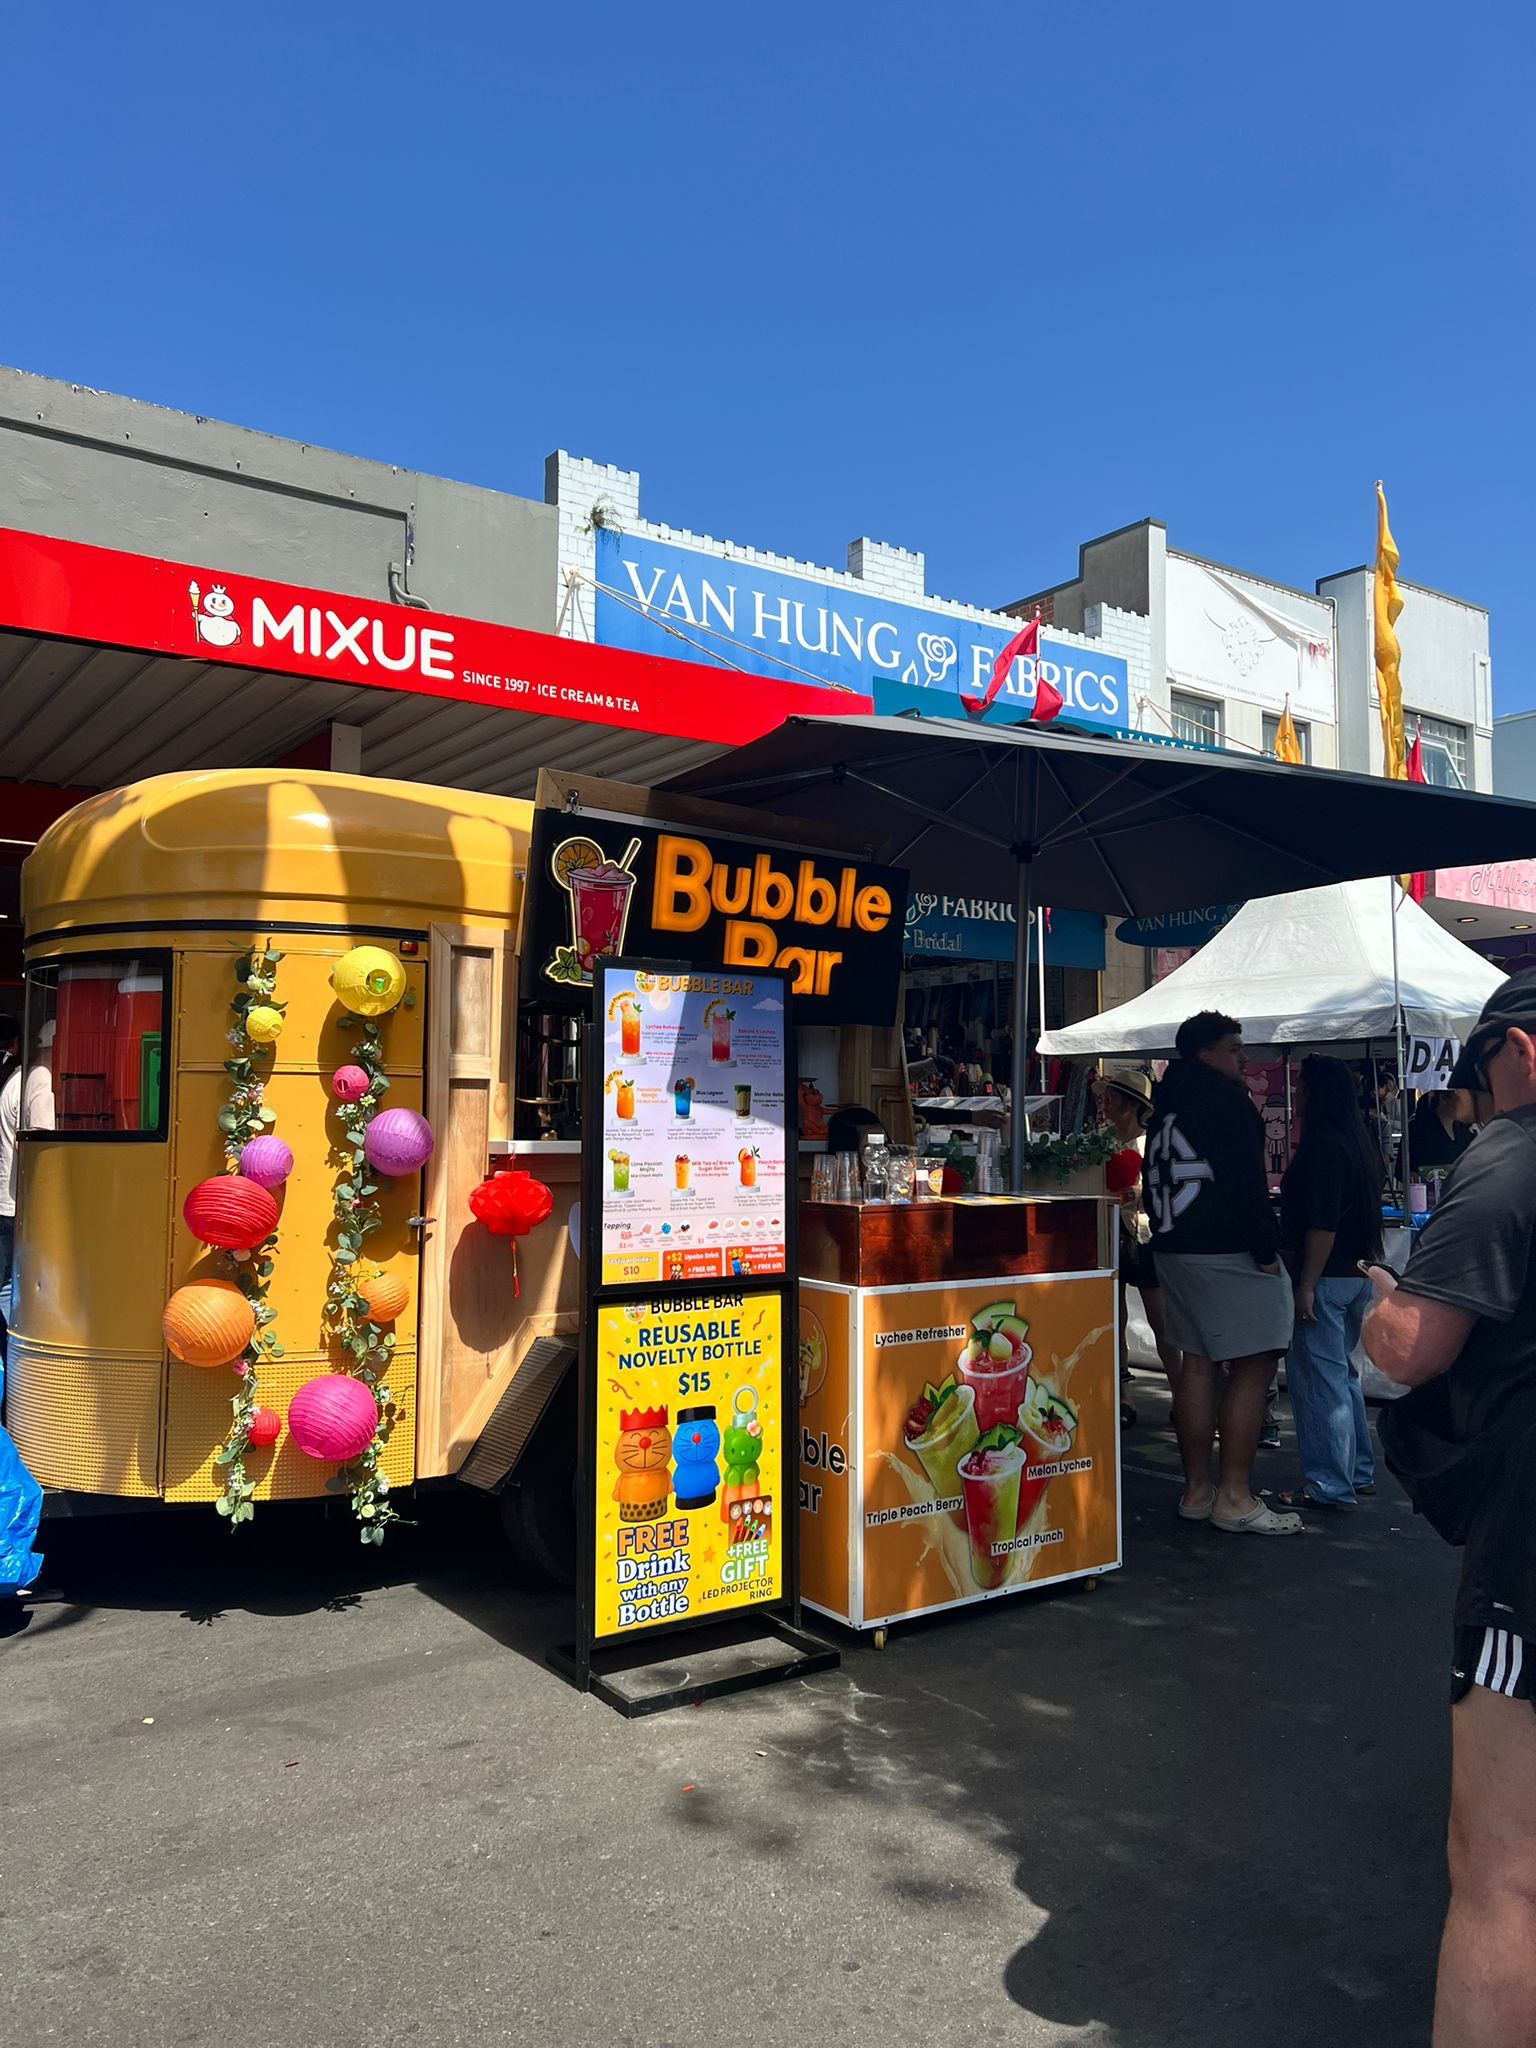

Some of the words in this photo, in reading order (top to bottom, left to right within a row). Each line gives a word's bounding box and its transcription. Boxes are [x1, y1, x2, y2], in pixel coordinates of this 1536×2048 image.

[622, 558, 737, 633] VAN
[751, 590, 903, 670] HUNG
[252, 597, 456, 681] MIXUE
[462, 670, 501, 689] SINCE
[504, 677, 530, 694] 1997
[537, 683, 558, 698] ICE
[560, 687, 603, 706] CREAM
[615, 697, 640, 712] TEA
[651, 834, 892, 933] Bubble
[1136, 914, 1165, 932] VAN
[1169, 906, 1217, 928] HUNG
[913, 929, 962, 951] Bridal
[657, 975, 721, 994] BUBBLE
[721, 977, 754, 996] BAR
[623, 1265, 640, 1276] $10
[650, 1296, 710, 1315] BUBBLE
[713, 1293, 744, 1310] BAR
[638, 1319, 741, 1348] REUSABLE
[874, 1330, 914, 1346] Lychee
[915, 1325, 966, 1341] Refresher
[618, 1346, 698, 1370] NOVELTY
[702, 1339, 762, 1361] BOTTLE
[678, 1371, 711, 1396] $15
[1028, 1464, 1057, 1479] Melon
[1058, 1458, 1092, 1475] Lychee
[866, 1511, 898, 1527] Triple
[899, 1503, 934, 1520] Peach
[935, 1497, 964, 1514] Berry
[617, 1518, 689, 1557] FREE
[727, 1540, 768, 1558] +FREE
[991, 1537, 1032, 1555] Tropical
[1034, 1529, 1063, 1545] Punch
[617, 1549, 690, 1584] Drink
[720, 1554, 769, 1584] GIFT
[620, 1581, 659, 1603] with
[660, 1577, 689, 1597] any
[702, 1588, 719, 1600] LED
[720, 1577, 773, 1596] PROJECTOR
[749, 1588, 773, 1600] RING
[617, 1594, 690, 1627] Bottle
